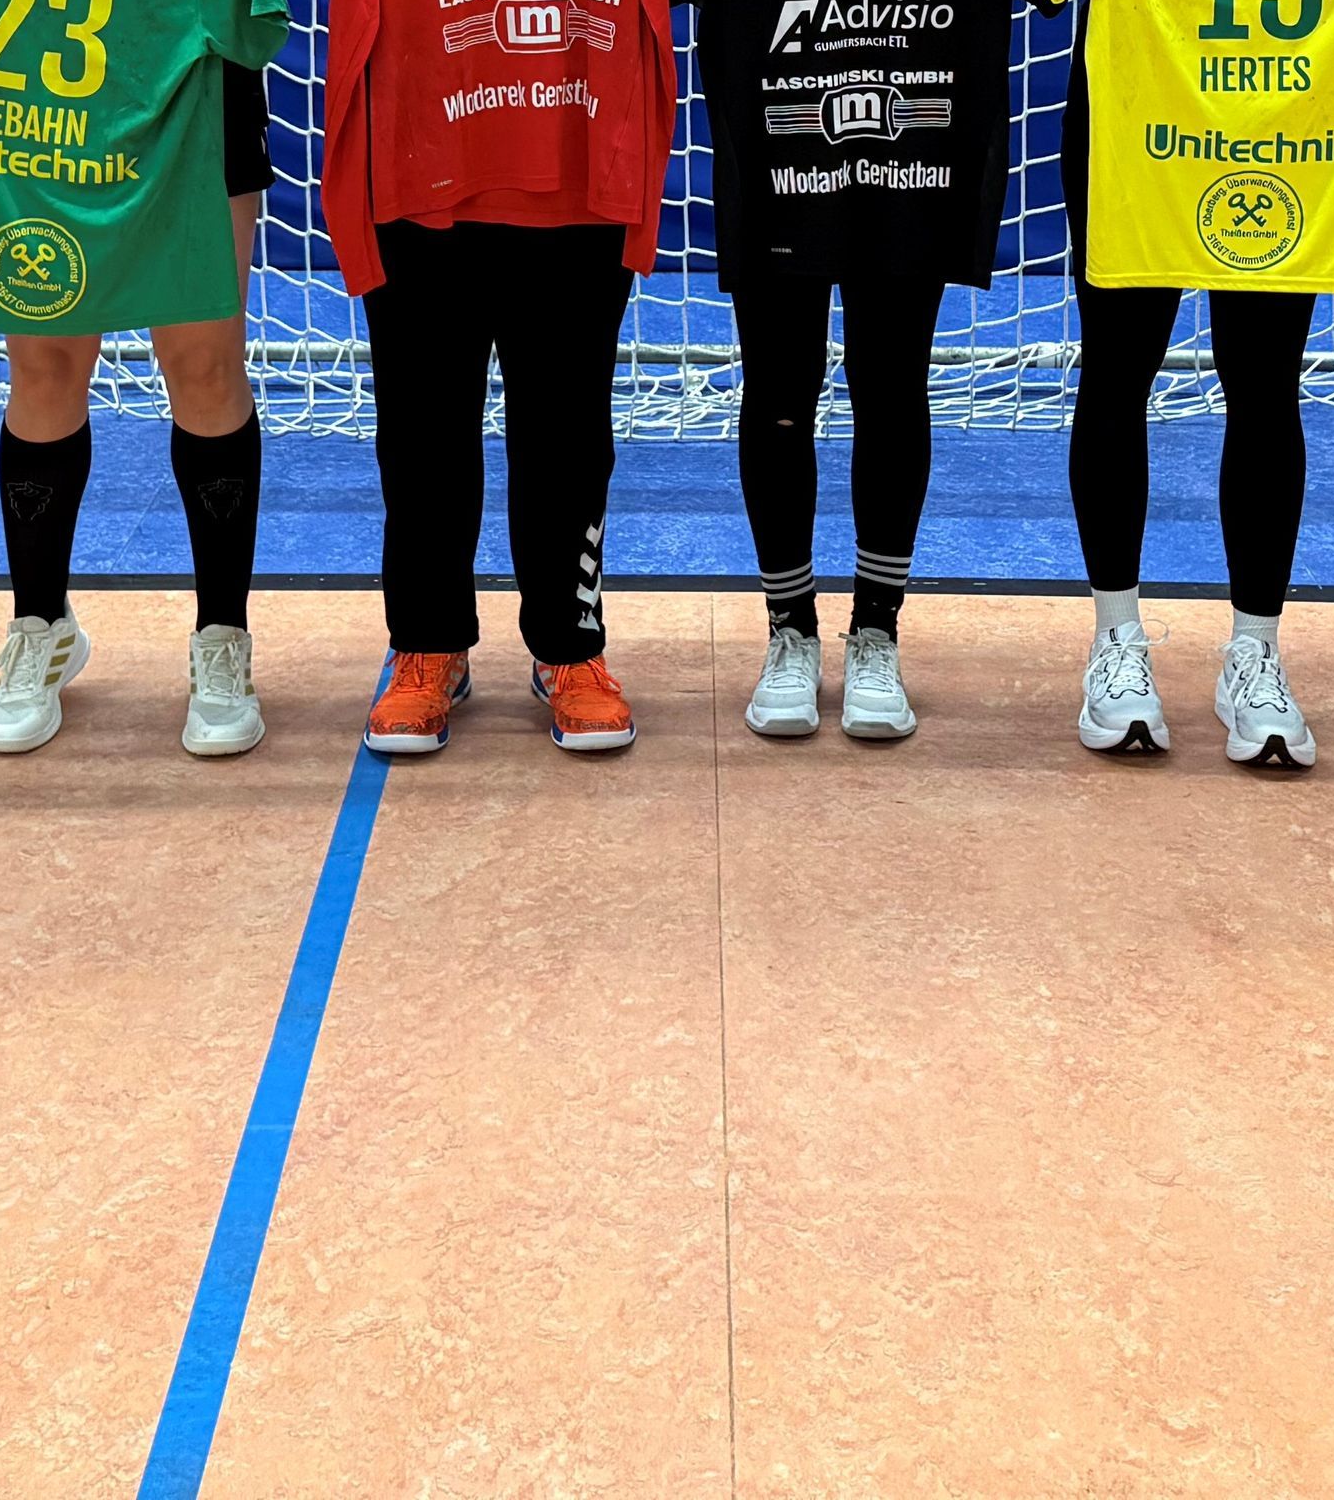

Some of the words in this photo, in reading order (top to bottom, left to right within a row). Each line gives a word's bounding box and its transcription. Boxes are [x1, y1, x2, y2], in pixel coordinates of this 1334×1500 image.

[814, 37, 886, 52] GUMMERSBACH
[888, 35, 909, 48] ETL
[762, 69, 884, 91] LASCHINSKI
[890, 71, 954, 85] GMBH
[1199, 55, 1312, 93] HERTES
[855, 158, 951, 190] Gerüstbau
